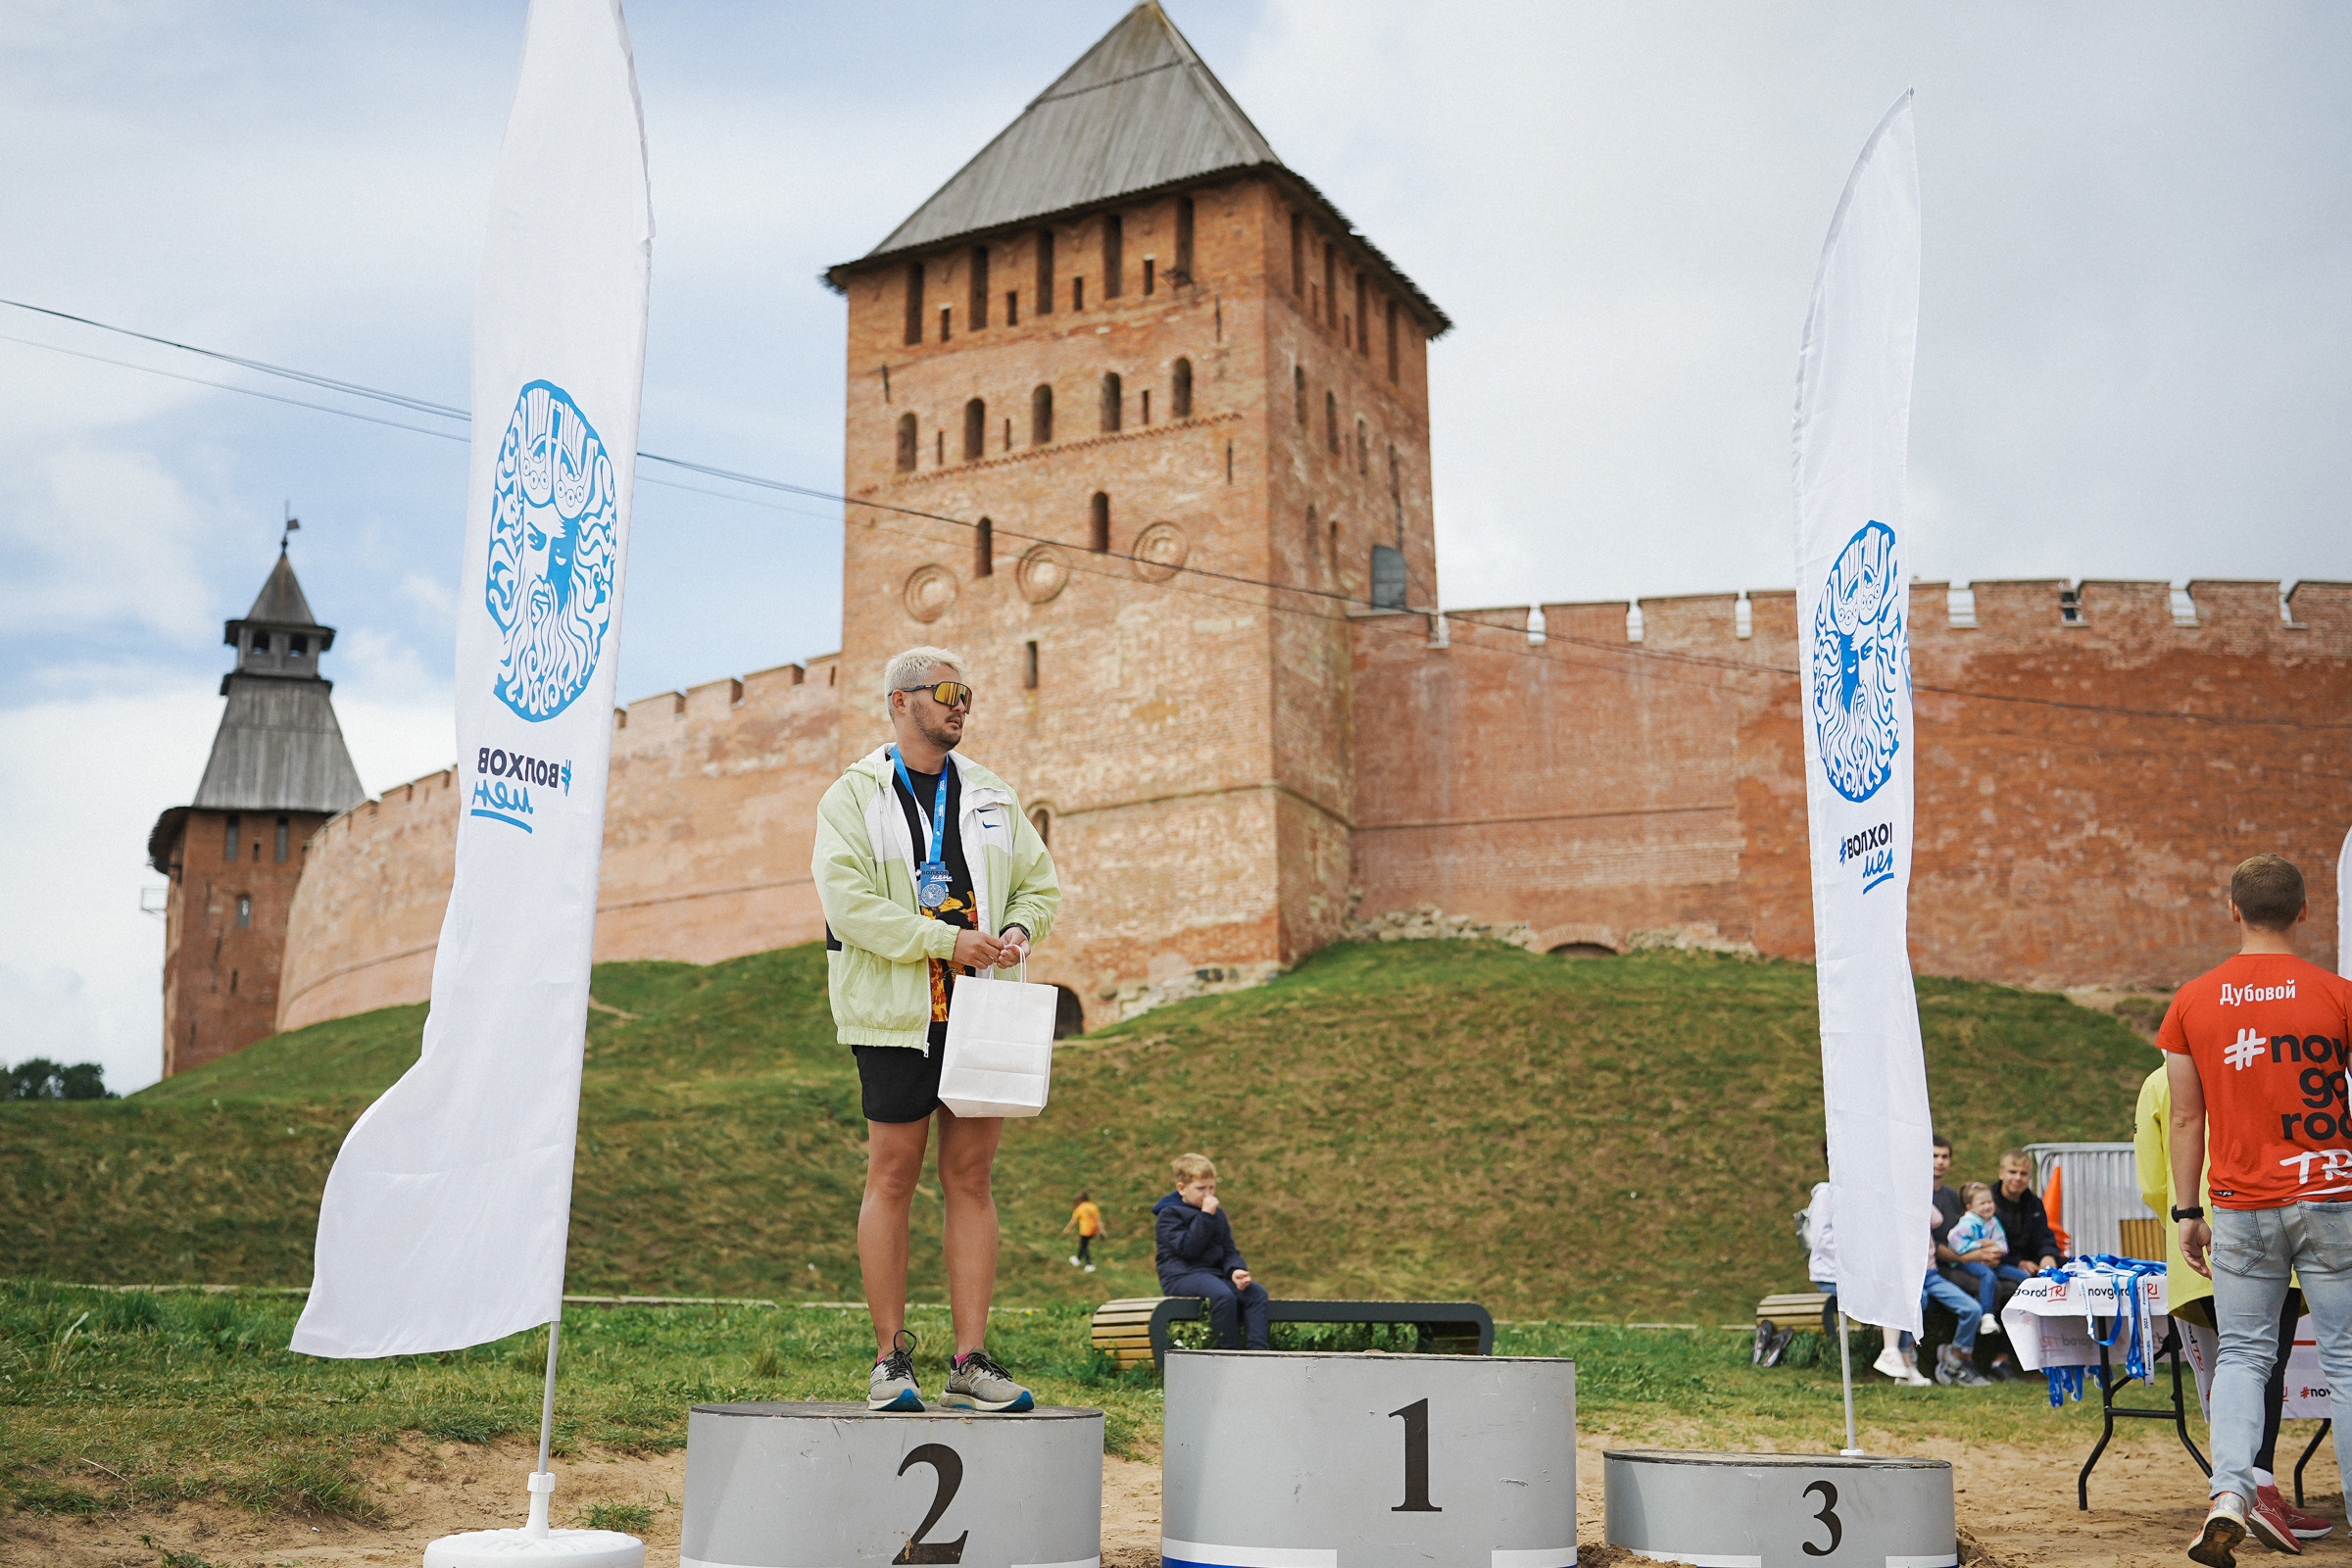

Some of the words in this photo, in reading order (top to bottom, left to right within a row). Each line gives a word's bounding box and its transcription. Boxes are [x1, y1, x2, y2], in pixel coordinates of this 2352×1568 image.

[1839, 821, 1892, 866] #ВОЛХО
[2219, 979, 2297, 1007] Дубовой
[2047, 1285, 2067, 1298] TRI
[1388, 1397, 1443, 1512] 1
[892, 1443, 969, 1566] 2
[1801, 1480, 1842, 1556] 3
